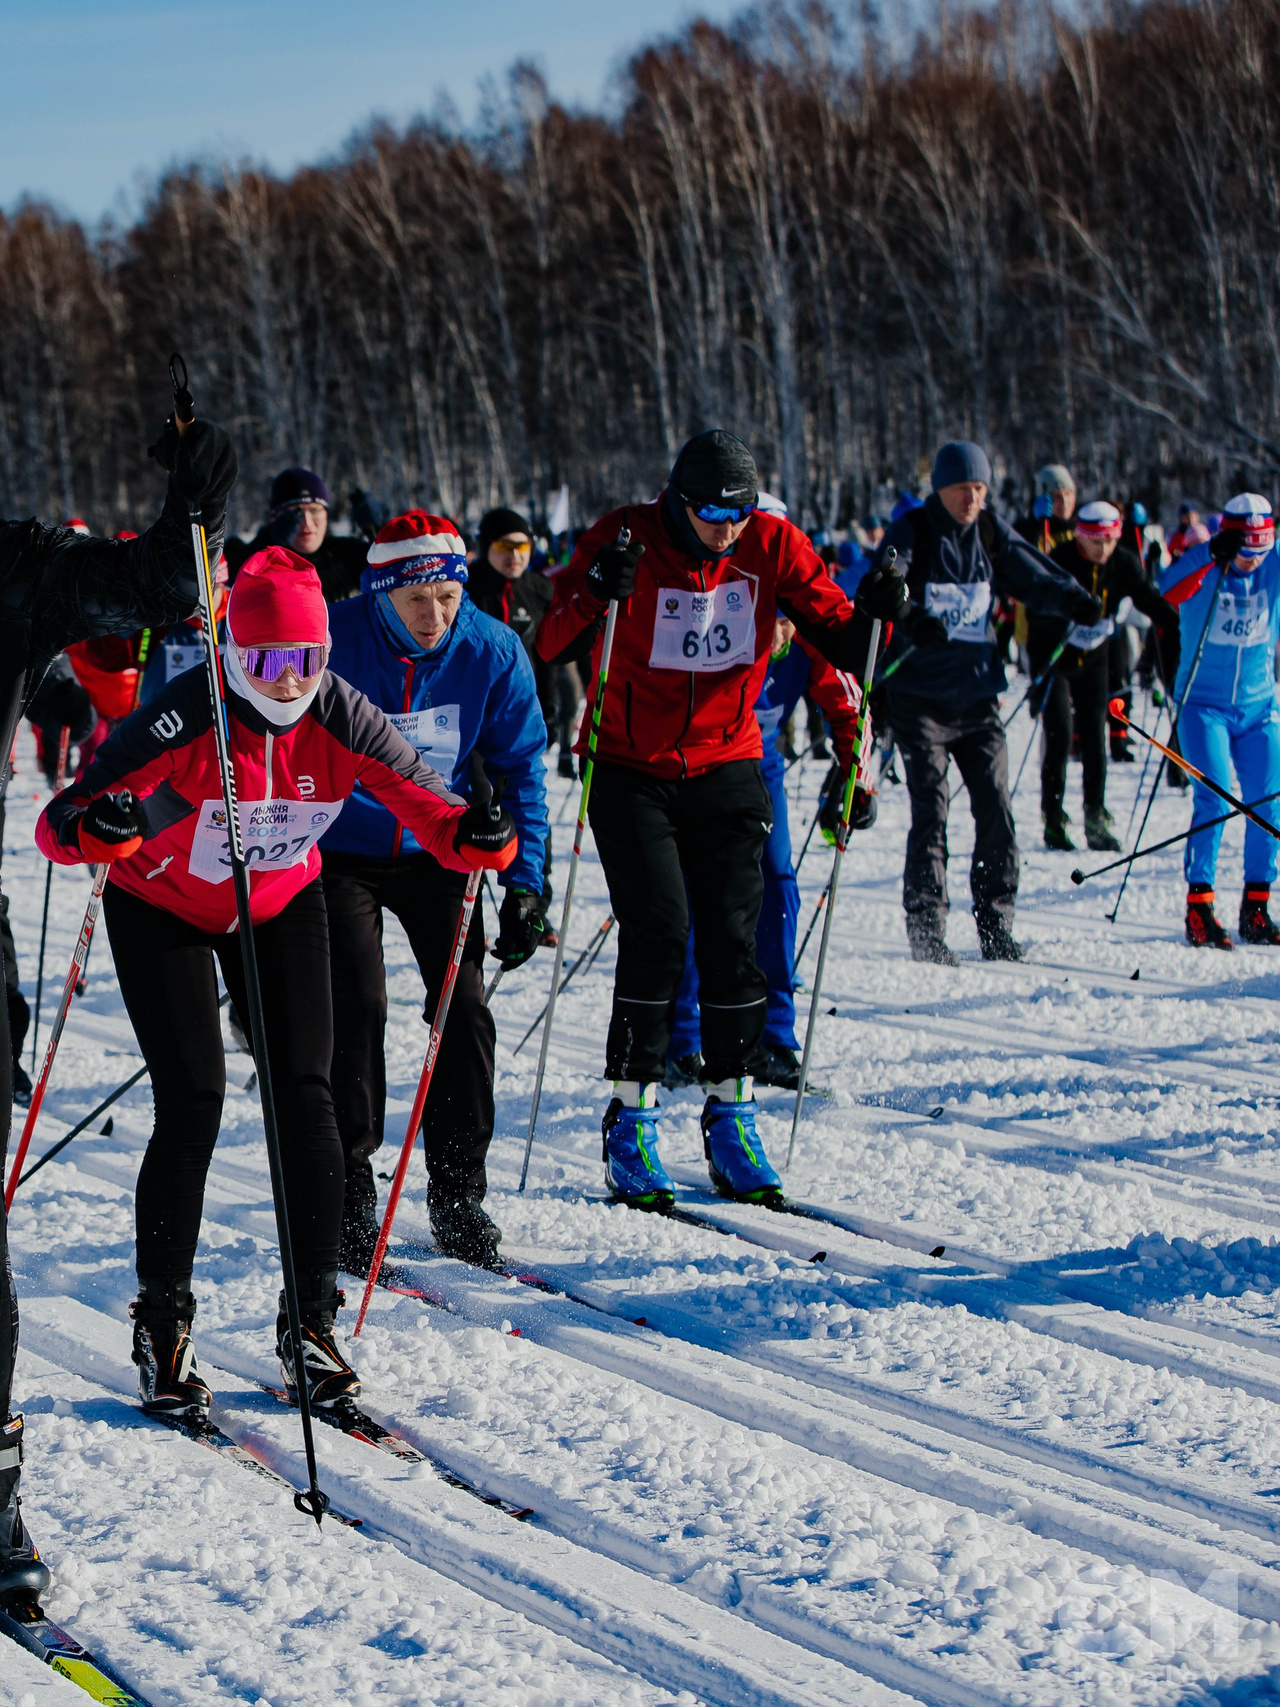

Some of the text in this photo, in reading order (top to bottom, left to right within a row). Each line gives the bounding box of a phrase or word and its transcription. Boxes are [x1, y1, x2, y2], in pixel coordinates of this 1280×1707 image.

[682, 623, 731, 658] 613
[394, 722, 418, 732] ОССИИ
[250, 804, 289, 816] ЛЫЖНЯ
[249, 814, 288, 825] РОССИИ
[246, 826, 288, 838] 2024
[217, 834, 311, 868] 3027
[426, 1031, 441, 1073] Cyber
